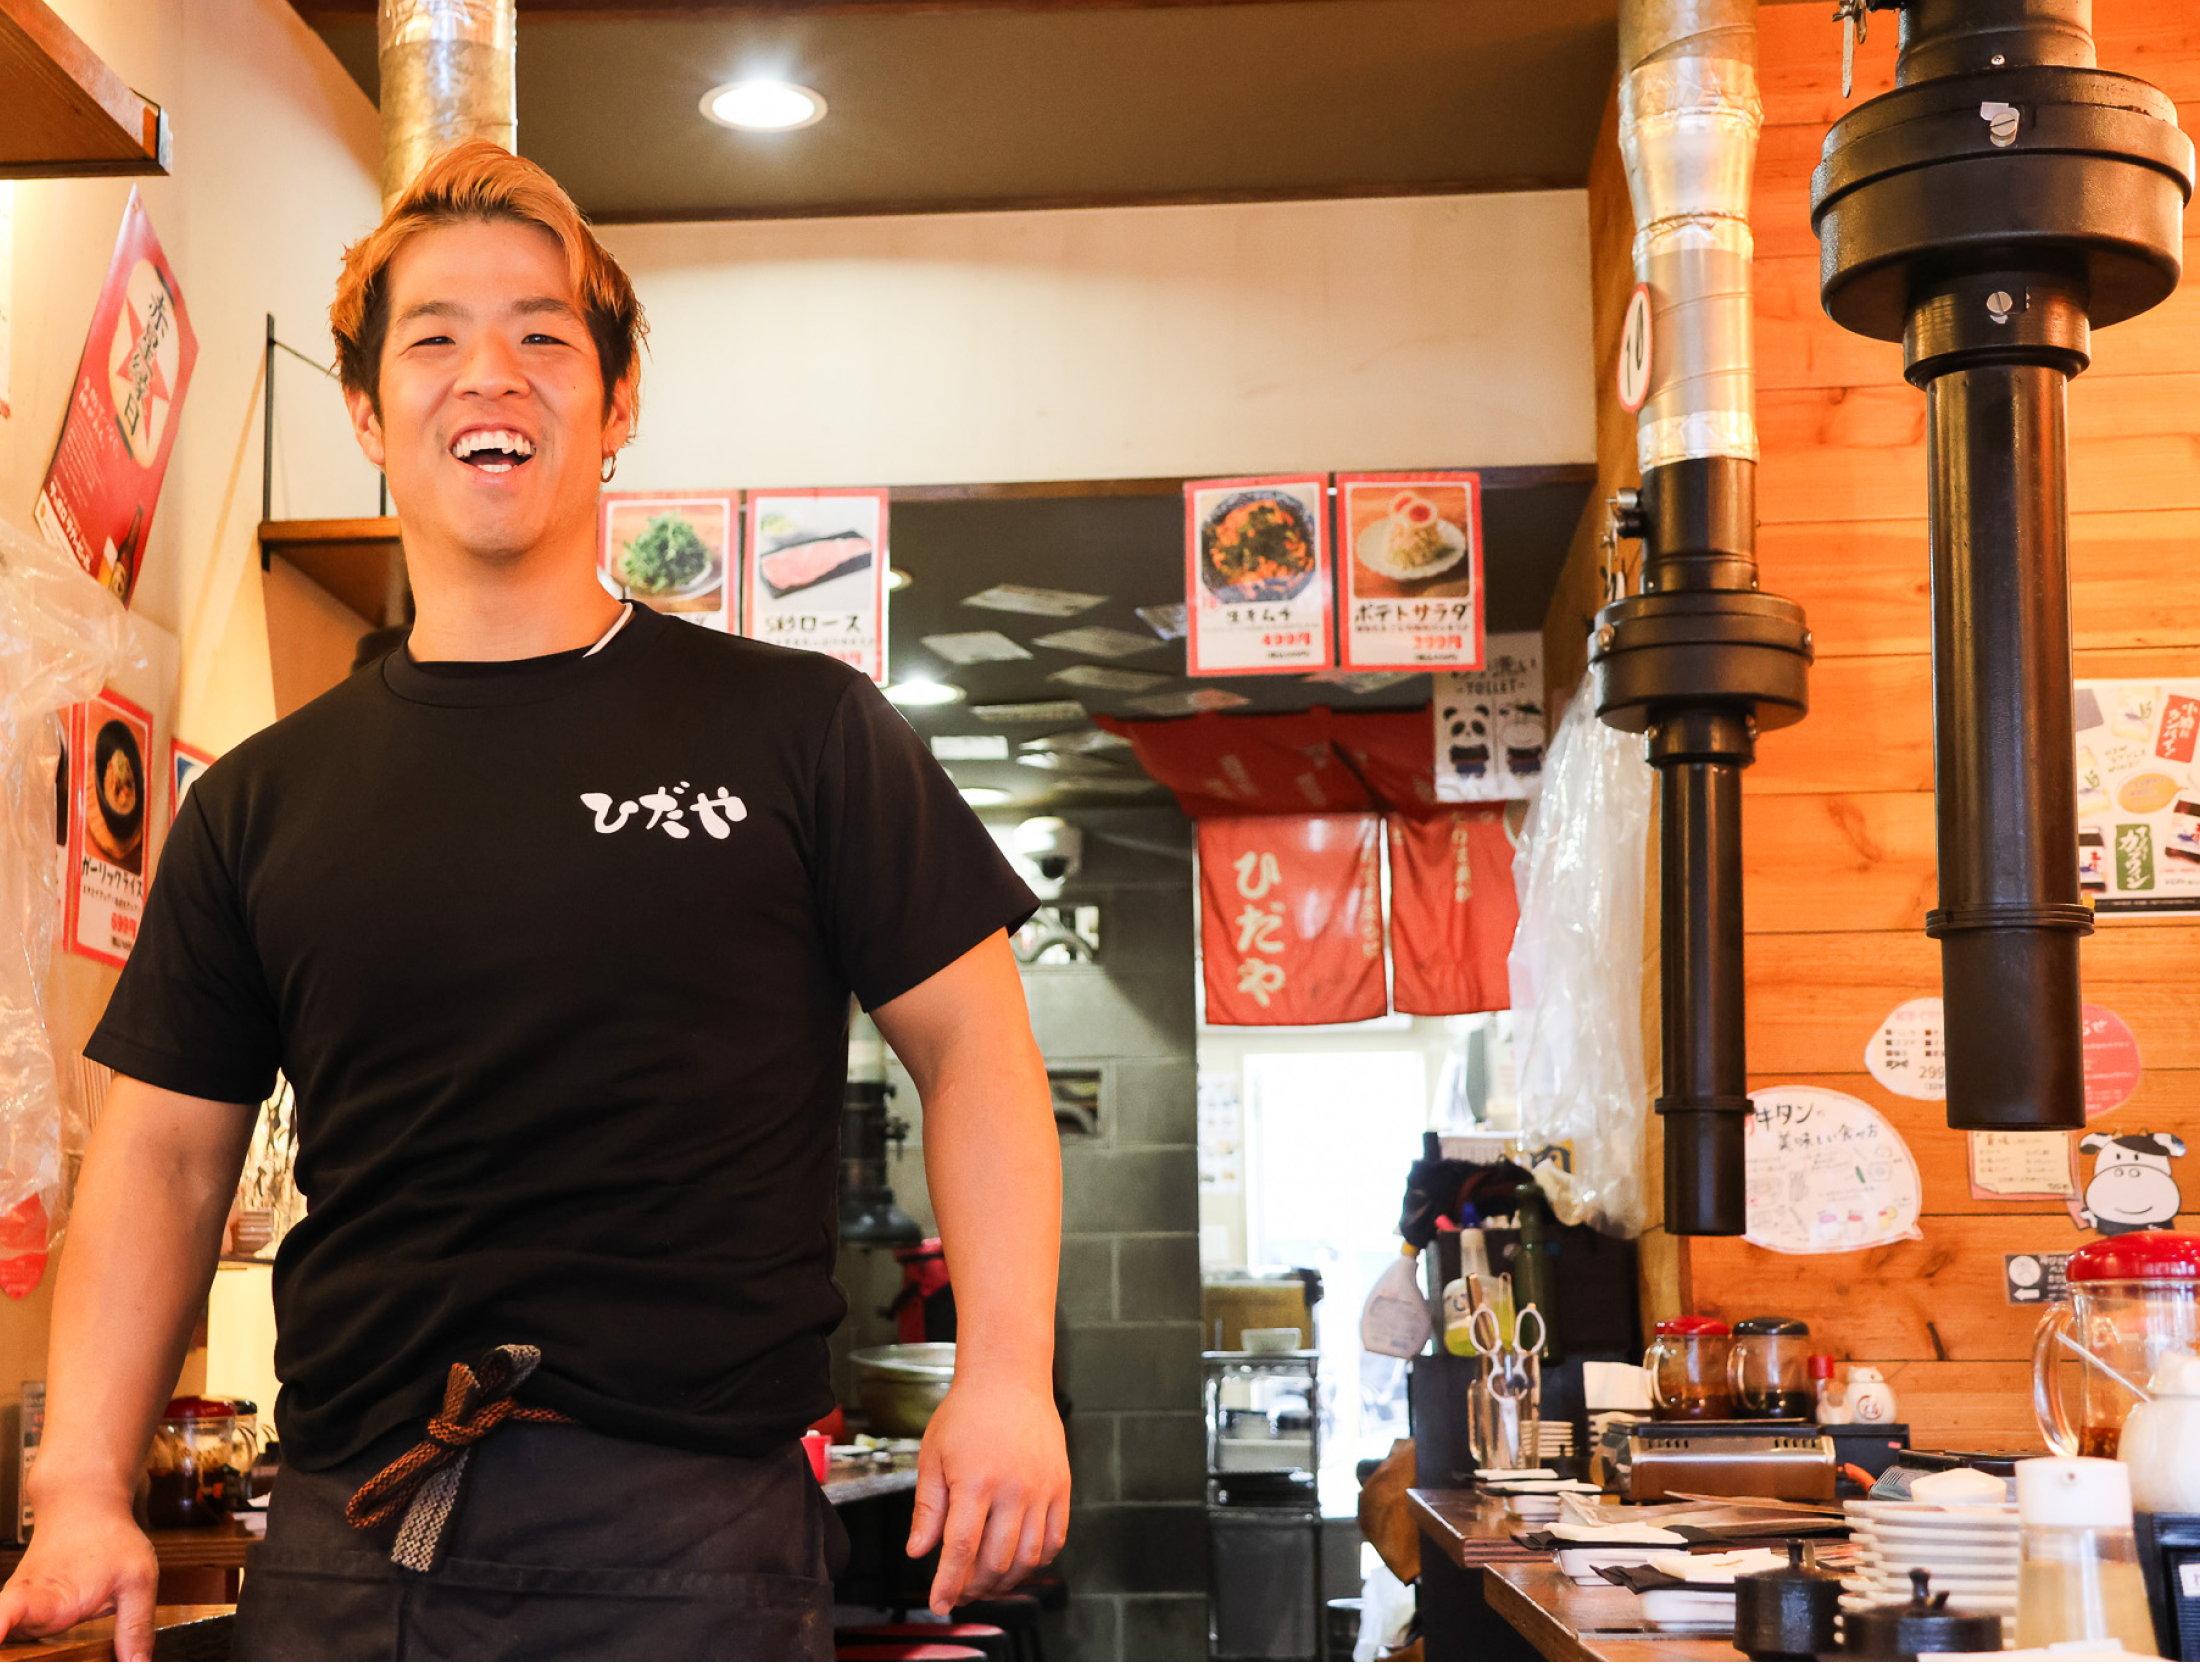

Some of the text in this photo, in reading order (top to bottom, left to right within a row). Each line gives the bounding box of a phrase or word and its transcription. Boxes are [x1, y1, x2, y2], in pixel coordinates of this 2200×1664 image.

[1226, 608, 1293, 623] 生キムチ
[1354, 602, 1472, 622] ポテトサラダ
[580, 781, 748, 840] ひだや
[82, 856, 143, 899] ガーリックライス
[1233, 850, 1287, 1008] ひだや
